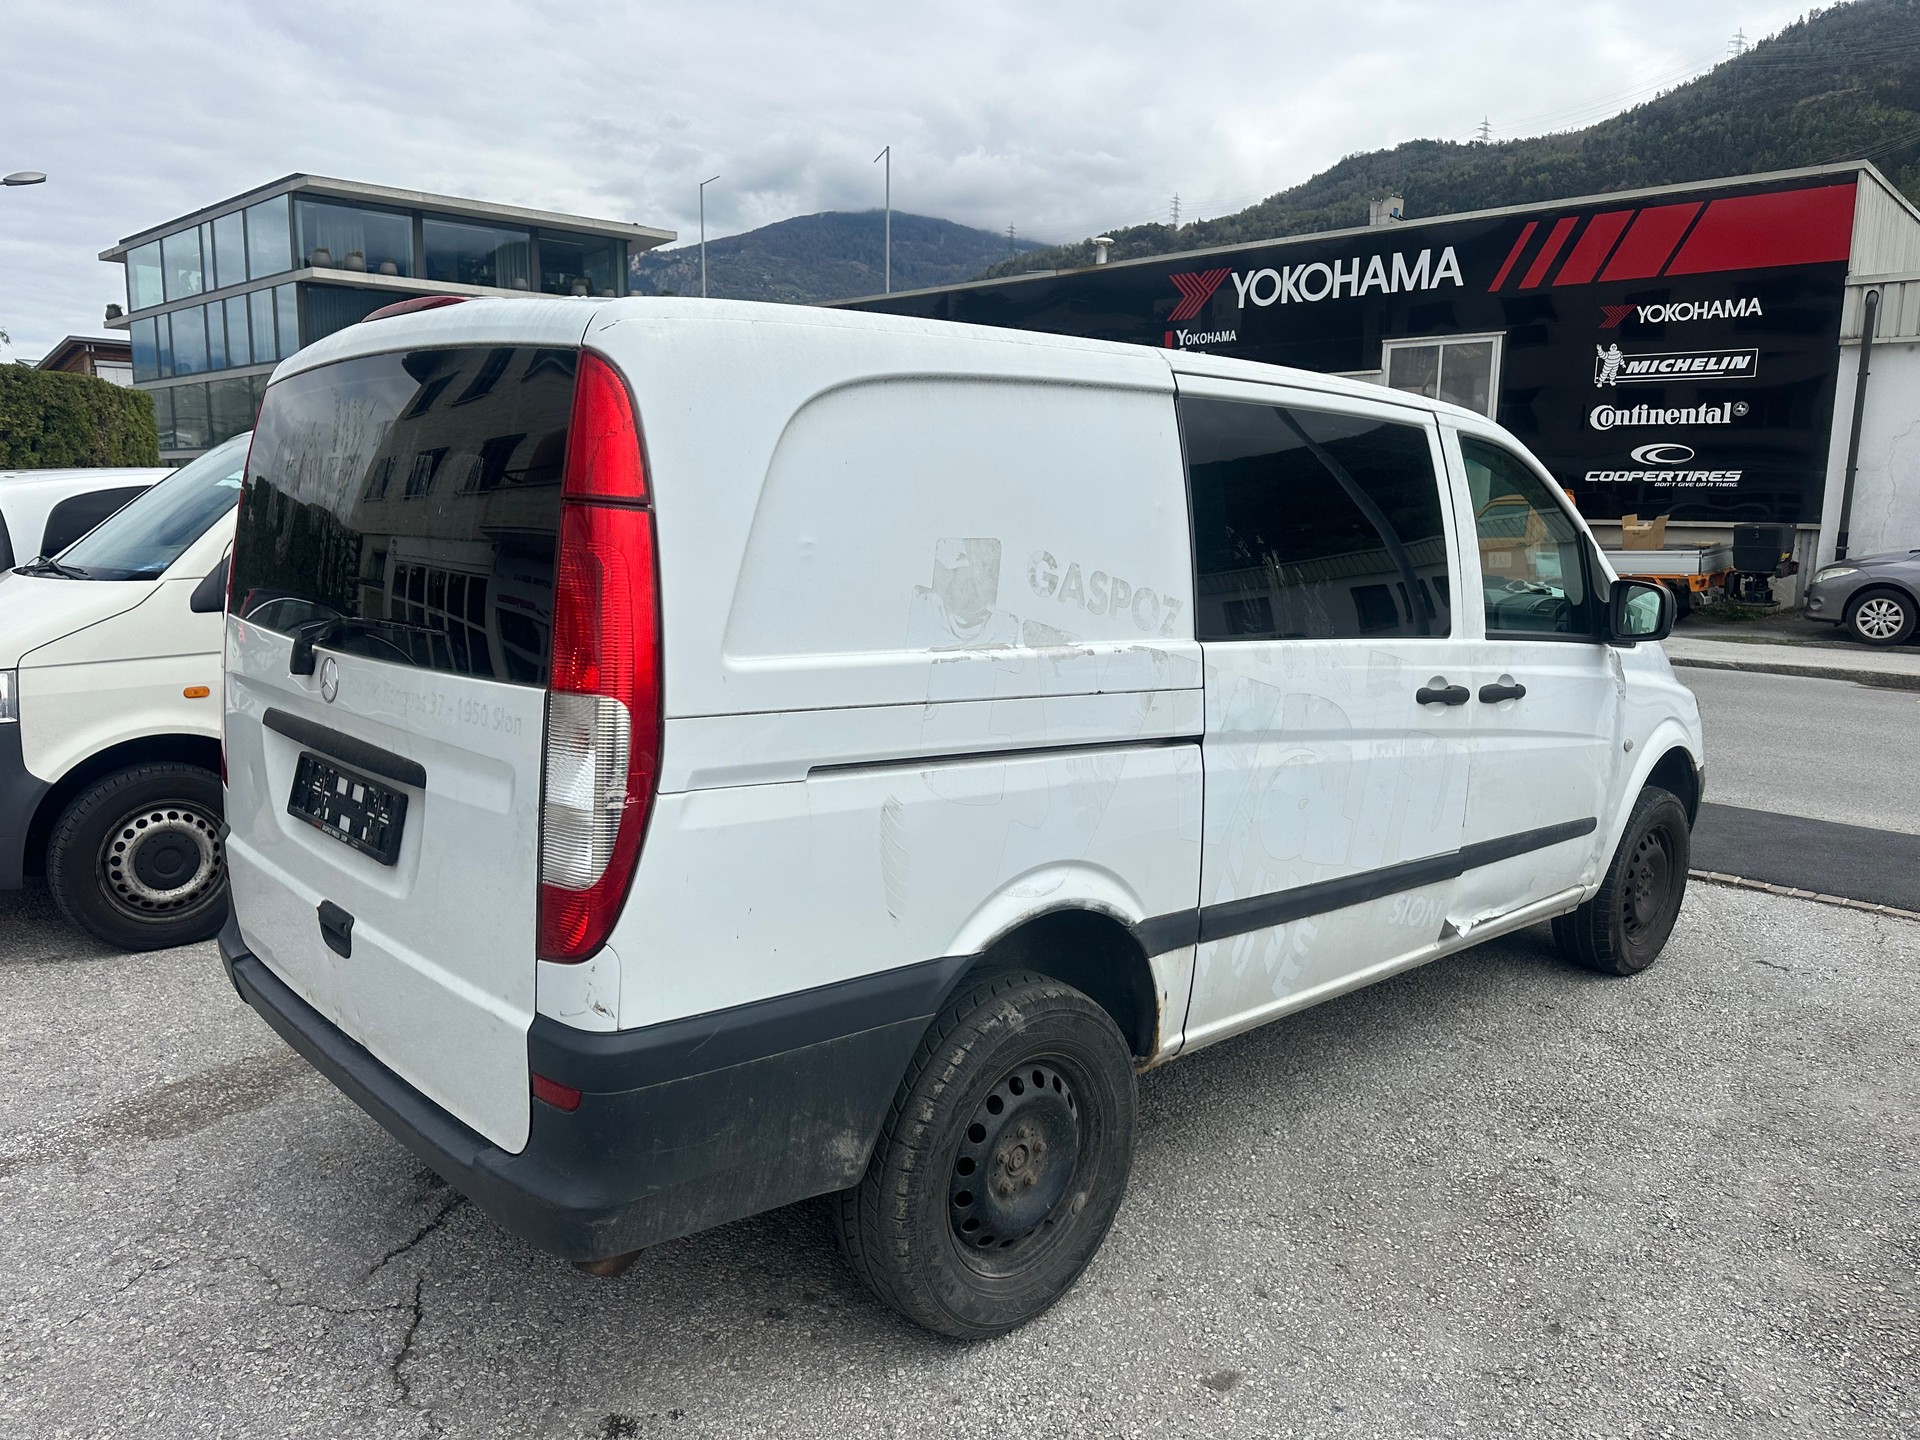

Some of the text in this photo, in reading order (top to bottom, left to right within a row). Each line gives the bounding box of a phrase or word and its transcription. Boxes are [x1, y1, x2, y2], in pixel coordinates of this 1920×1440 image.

[1231, 246, 1464, 309] YOKOHAMA
[1636, 297, 1763, 324] YOKOHAMA
[1176, 329, 1237, 346] YOKOHAMA
[1625, 355, 1752, 374] MICHELIN
[1589, 402, 1732, 431] Continental
[1584, 470, 1743, 482] COOPERTIRES
[1027, 550, 1184, 638] GASPOZ
[457, 696, 489, 728] 1950
[492, 707, 523, 736] Sion
[1387, 893, 1443, 928] SION
